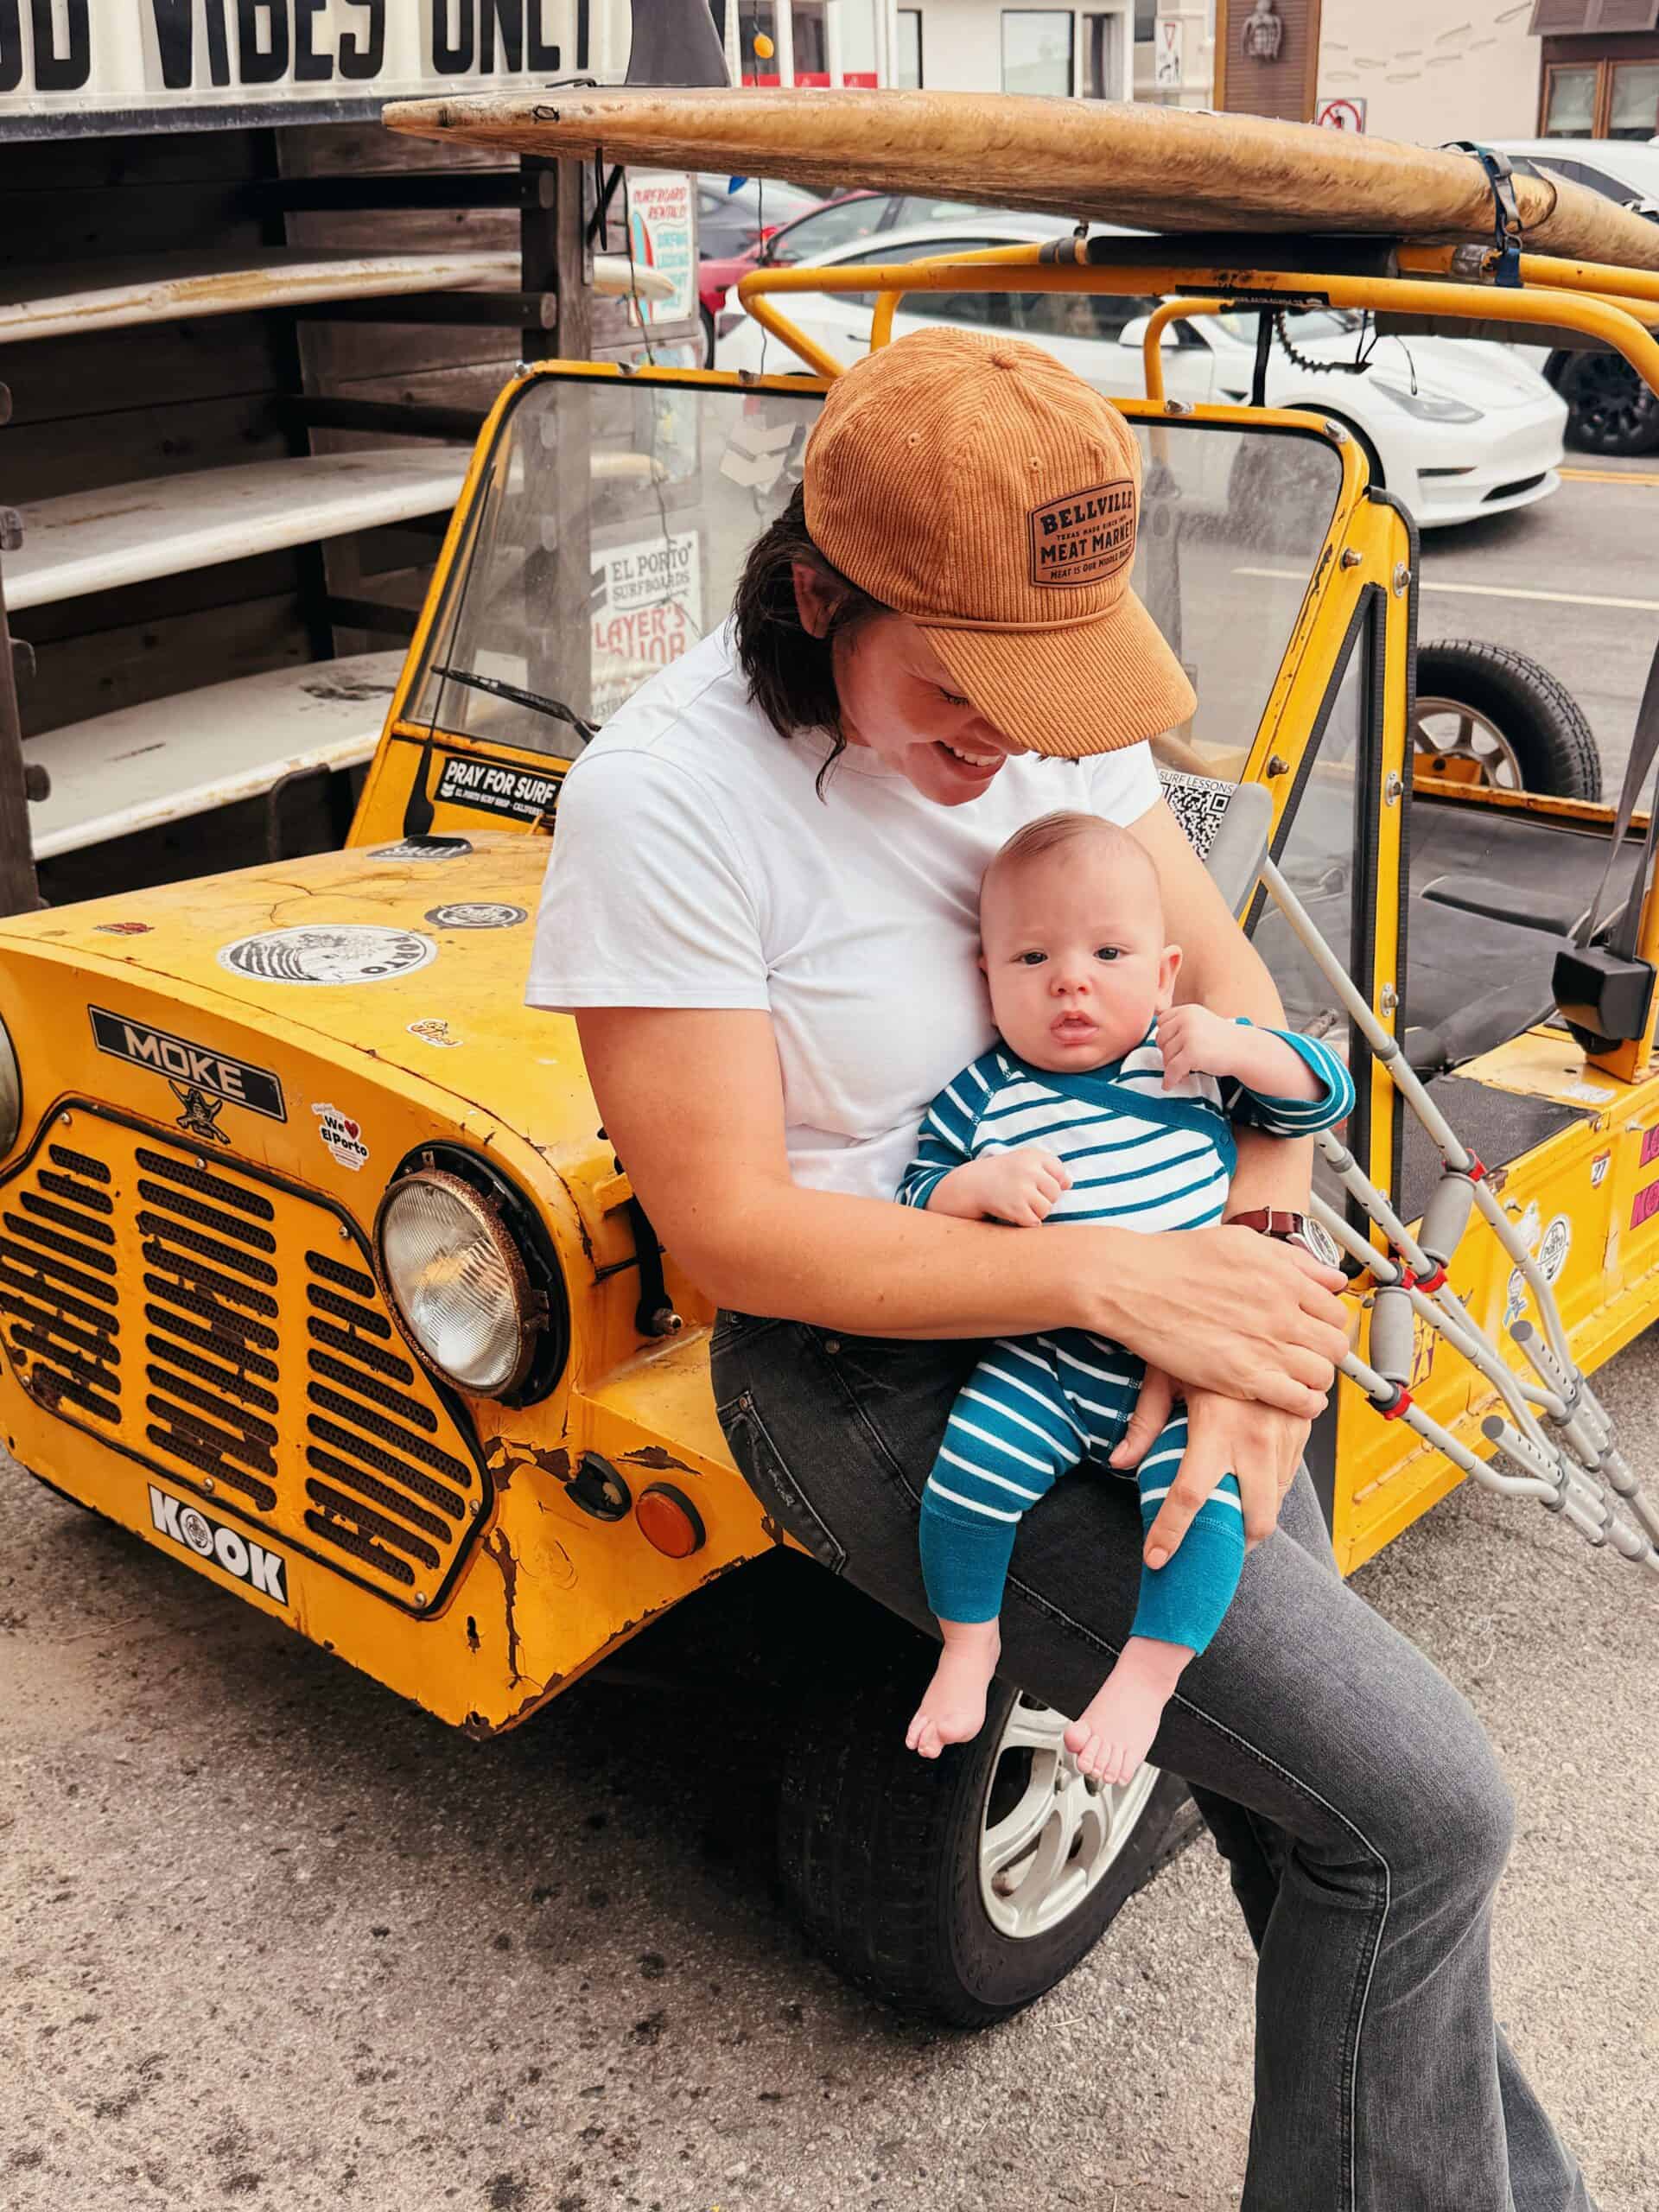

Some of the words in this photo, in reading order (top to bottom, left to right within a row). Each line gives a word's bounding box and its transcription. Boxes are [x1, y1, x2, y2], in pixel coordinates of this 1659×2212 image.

[1039, 538, 1088, 565] MEAT
[1092, 518, 1134, 553] MARKET
[611, 559, 634, 582] EL
[637, 546, 690, 577] PORTO
[445, 760, 486, 788] PRAY
[482, 769, 517, 796] FOR
[514, 777, 556, 804] SURF
[1159, 771, 1186, 784] SURF
[1186, 776, 1234, 794] LESSONS
[361, 936, 422, 974] PORTO
[124, 1024, 247, 1100] MOKE
[321, 1128, 332, 1141] El
[333, 1132, 368, 1157] Porto
[324, 1115, 345, 1133] We
[1592, 1158, 1607, 1184] 27
[149, 1484, 287, 1605] KOOK
